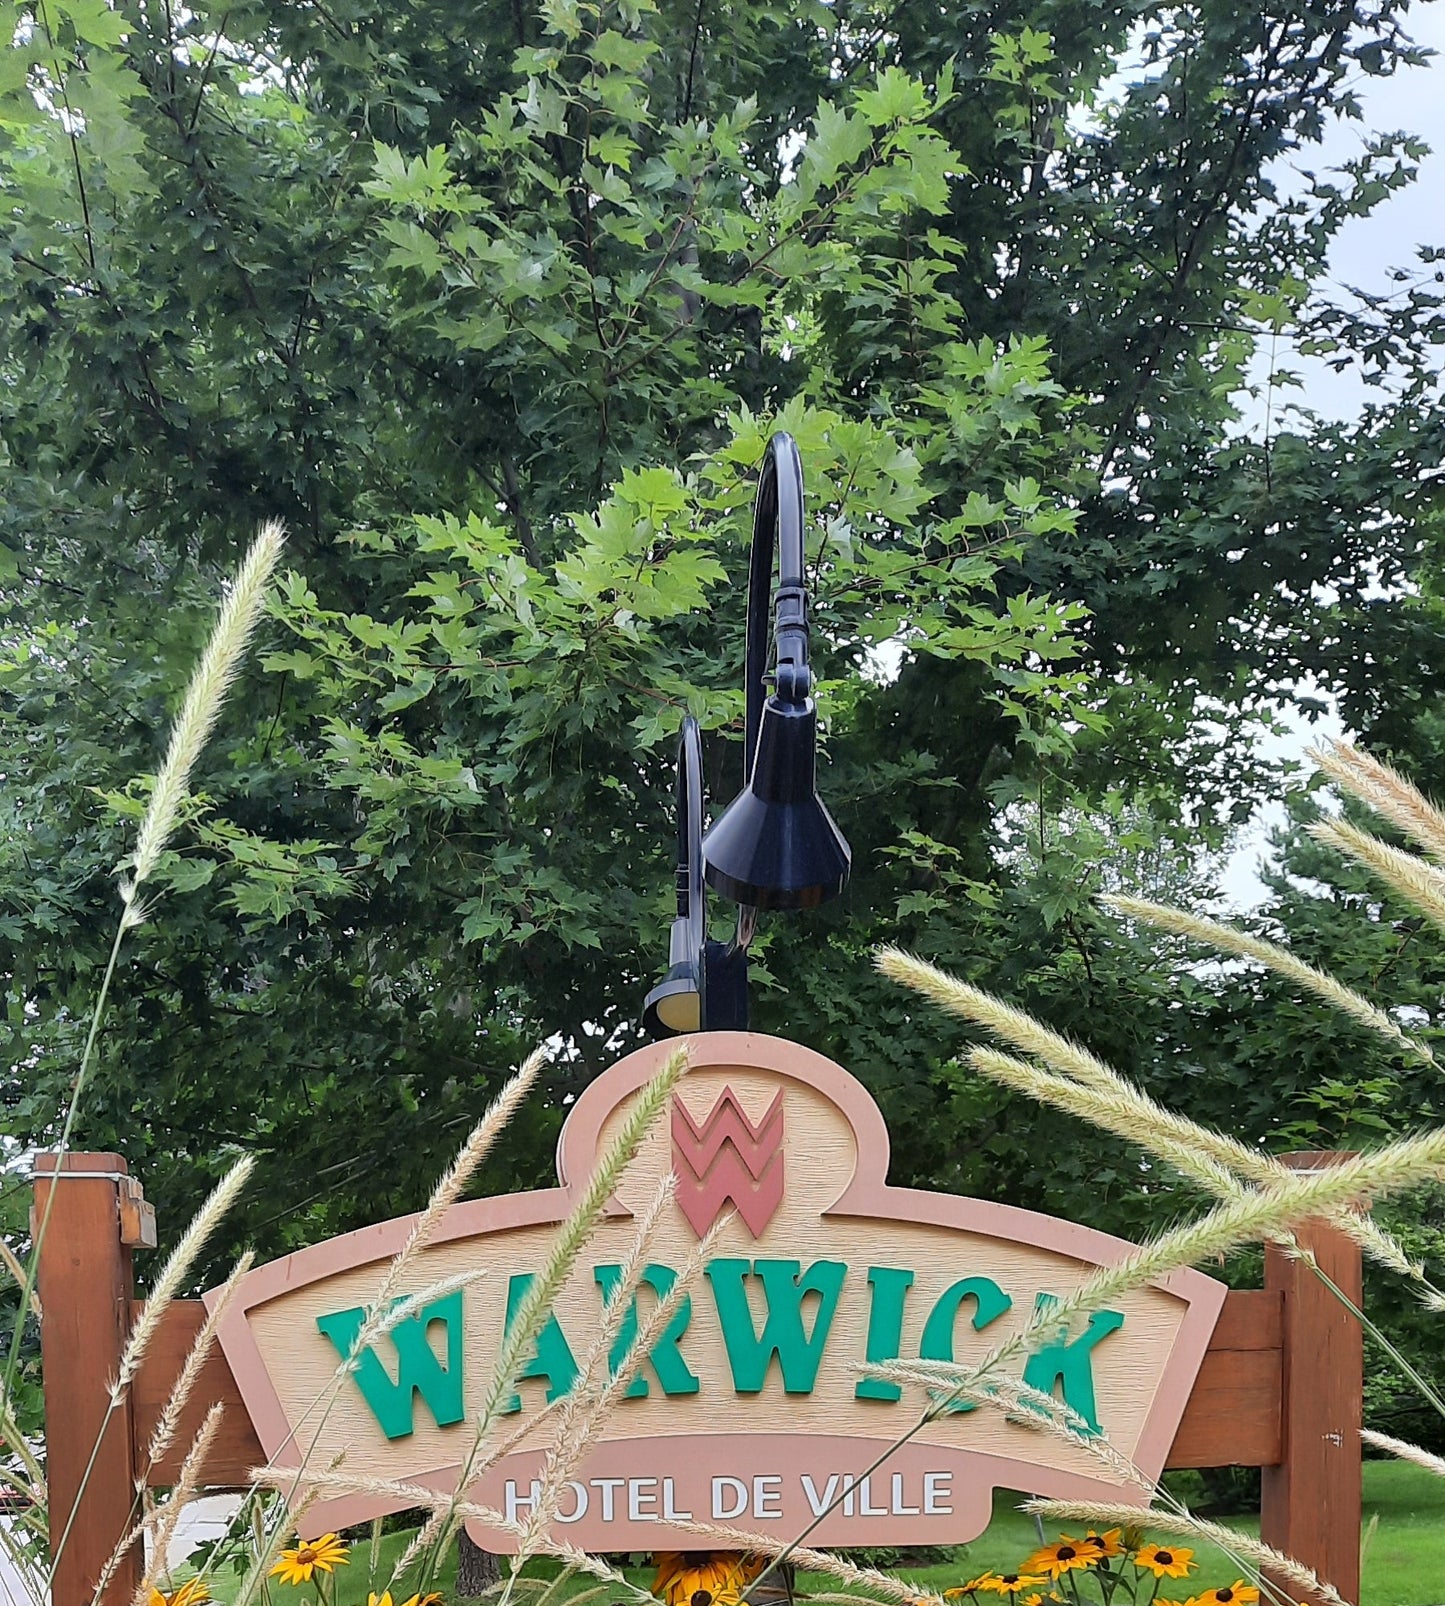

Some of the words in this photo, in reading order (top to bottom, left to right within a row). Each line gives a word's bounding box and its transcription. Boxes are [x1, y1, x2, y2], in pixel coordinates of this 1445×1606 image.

[315, 1258, 1125, 1440] WARWICK
[504, 1478, 692, 1523] HOTEL
[711, 1475, 783, 1519] DE
[800, 1472, 954, 1517] VILLE
